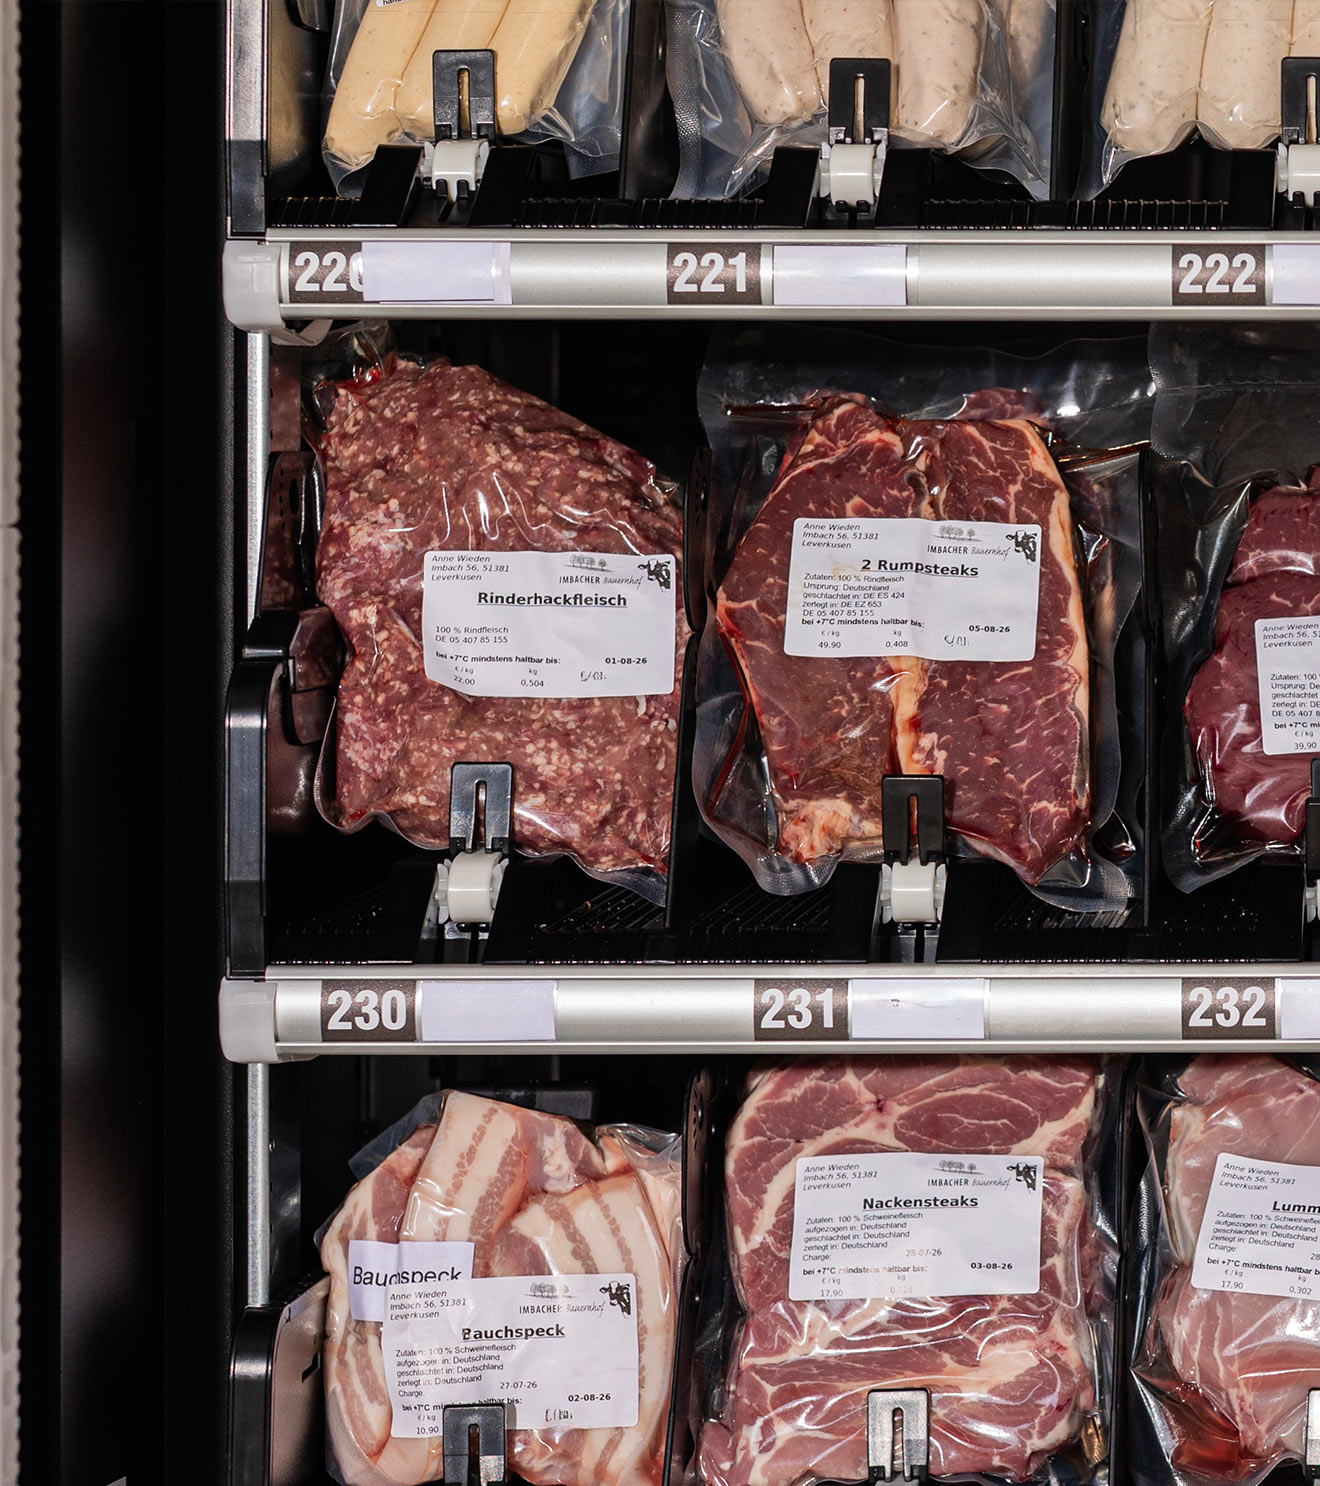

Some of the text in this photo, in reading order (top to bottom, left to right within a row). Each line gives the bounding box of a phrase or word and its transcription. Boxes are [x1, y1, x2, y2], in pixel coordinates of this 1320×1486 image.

[673, 252, 744, 292] 221
[1179, 253, 1253, 293] 222
[829, 523, 860, 531] Wieden
[803, 532, 834, 540] Imbach
[837, 532, 851, 540] 56,
[802, 541, 851, 549] Leverkusen
[927, 545, 968, 555] IMBACHER
[432, 564, 463, 572] Imbach
[466, 564, 480, 572] 56,
[862, 559, 979, 576] 2 Rumpsteaks
[559, 576, 644, 590] IMBACHER Bauernhof
[478, 592, 627, 606] Rinderhackfleisch
[803, 591, 850, 600] geschlachtet
[464, 626, 509, 634] Rindfleisch
[969, 625, 1010, 633] 05-08-26
[1263, 622, 1319, 632] Anne Wieden
[1263, 632, 1294, 640] Imbach
[1297, 632, 1311, 640] 56,
[1263, 640, 1313, 648] Leverkusen
[436, 652, 448, 660] bei
[515, 656, 543, 664] haltbar
[520, 679, 544, 687] 0,504
[328, 990, 404, 1030] 230
[760, 988, 836, 1028] 231
[1188, 986, 1267, 1027] 232
[804, 1162, 860, 1173] Anne Wieden
[1223, 1162, 1280, 1177] Anne Wieden
[836, 1172, 850, 1180] 56,
[853, 1171, 878, 1179] 51381
[1221, 1171, 1296, 1185] Imbach 56, 51381
[803, 1181, 851, 1191] Leverkusen
[928, 1178, 969, 1186] IMBACHER
[1219, 1180, 1268, 1191] Leverkusen
[863, 1196, 978, 1210] Nackensteaks
[805, 1224, 848, 1234] aufgezogen
[860, 1221, 907, 1230] Deutschland
[971, 1262, 1013, 1270] 03-08-26
[1207, 1258, 1219, 1267] bei
[1242, 1261, 1282, 1271] mindstens
[1285, 1264, 1312, 1275] haltbar
[353, 1266, 462, 1286] Baucspeck
[390, 1290, 447, 1300] Anne Wieden
[390, 1298, 466, 1311] Imbach 56, 51381
[390, 1310, 440, 1321] Leverkusen
[462, 1324, 565, 1340] Bauchspeck
[500, 1381, 537, 1390] 27-07-26
[568, 1394, 611, 1402] 02-08-26
